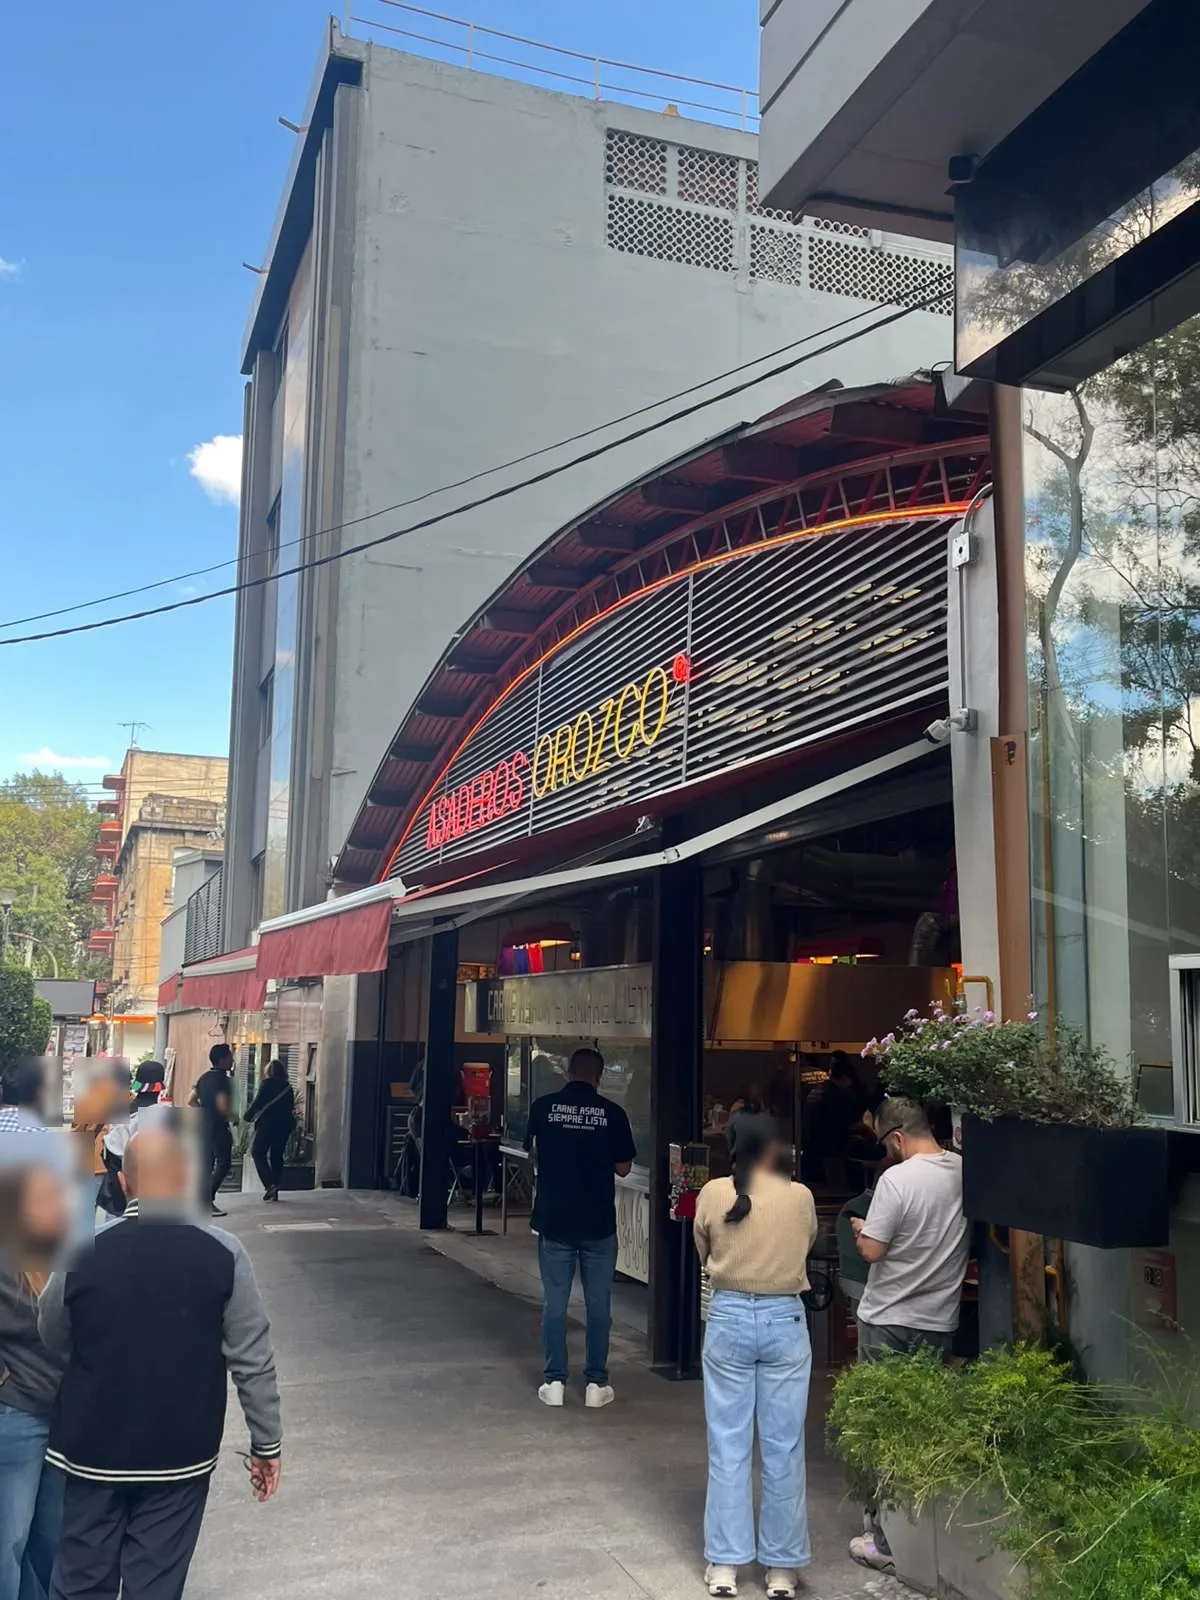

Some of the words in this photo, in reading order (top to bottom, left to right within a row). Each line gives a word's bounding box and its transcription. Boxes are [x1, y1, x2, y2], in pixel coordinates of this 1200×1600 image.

[425, 751, 528, 849] ASADEROS
[532, 667, 668, 798] OROZCO
[551, 1103, 578, 1114] CARNE
[579, 1106, 605, 1117] ASADA
[547, 1113, 584, 1124] SIEMPRE
[585, 1116, 608, 1127] LISTA
